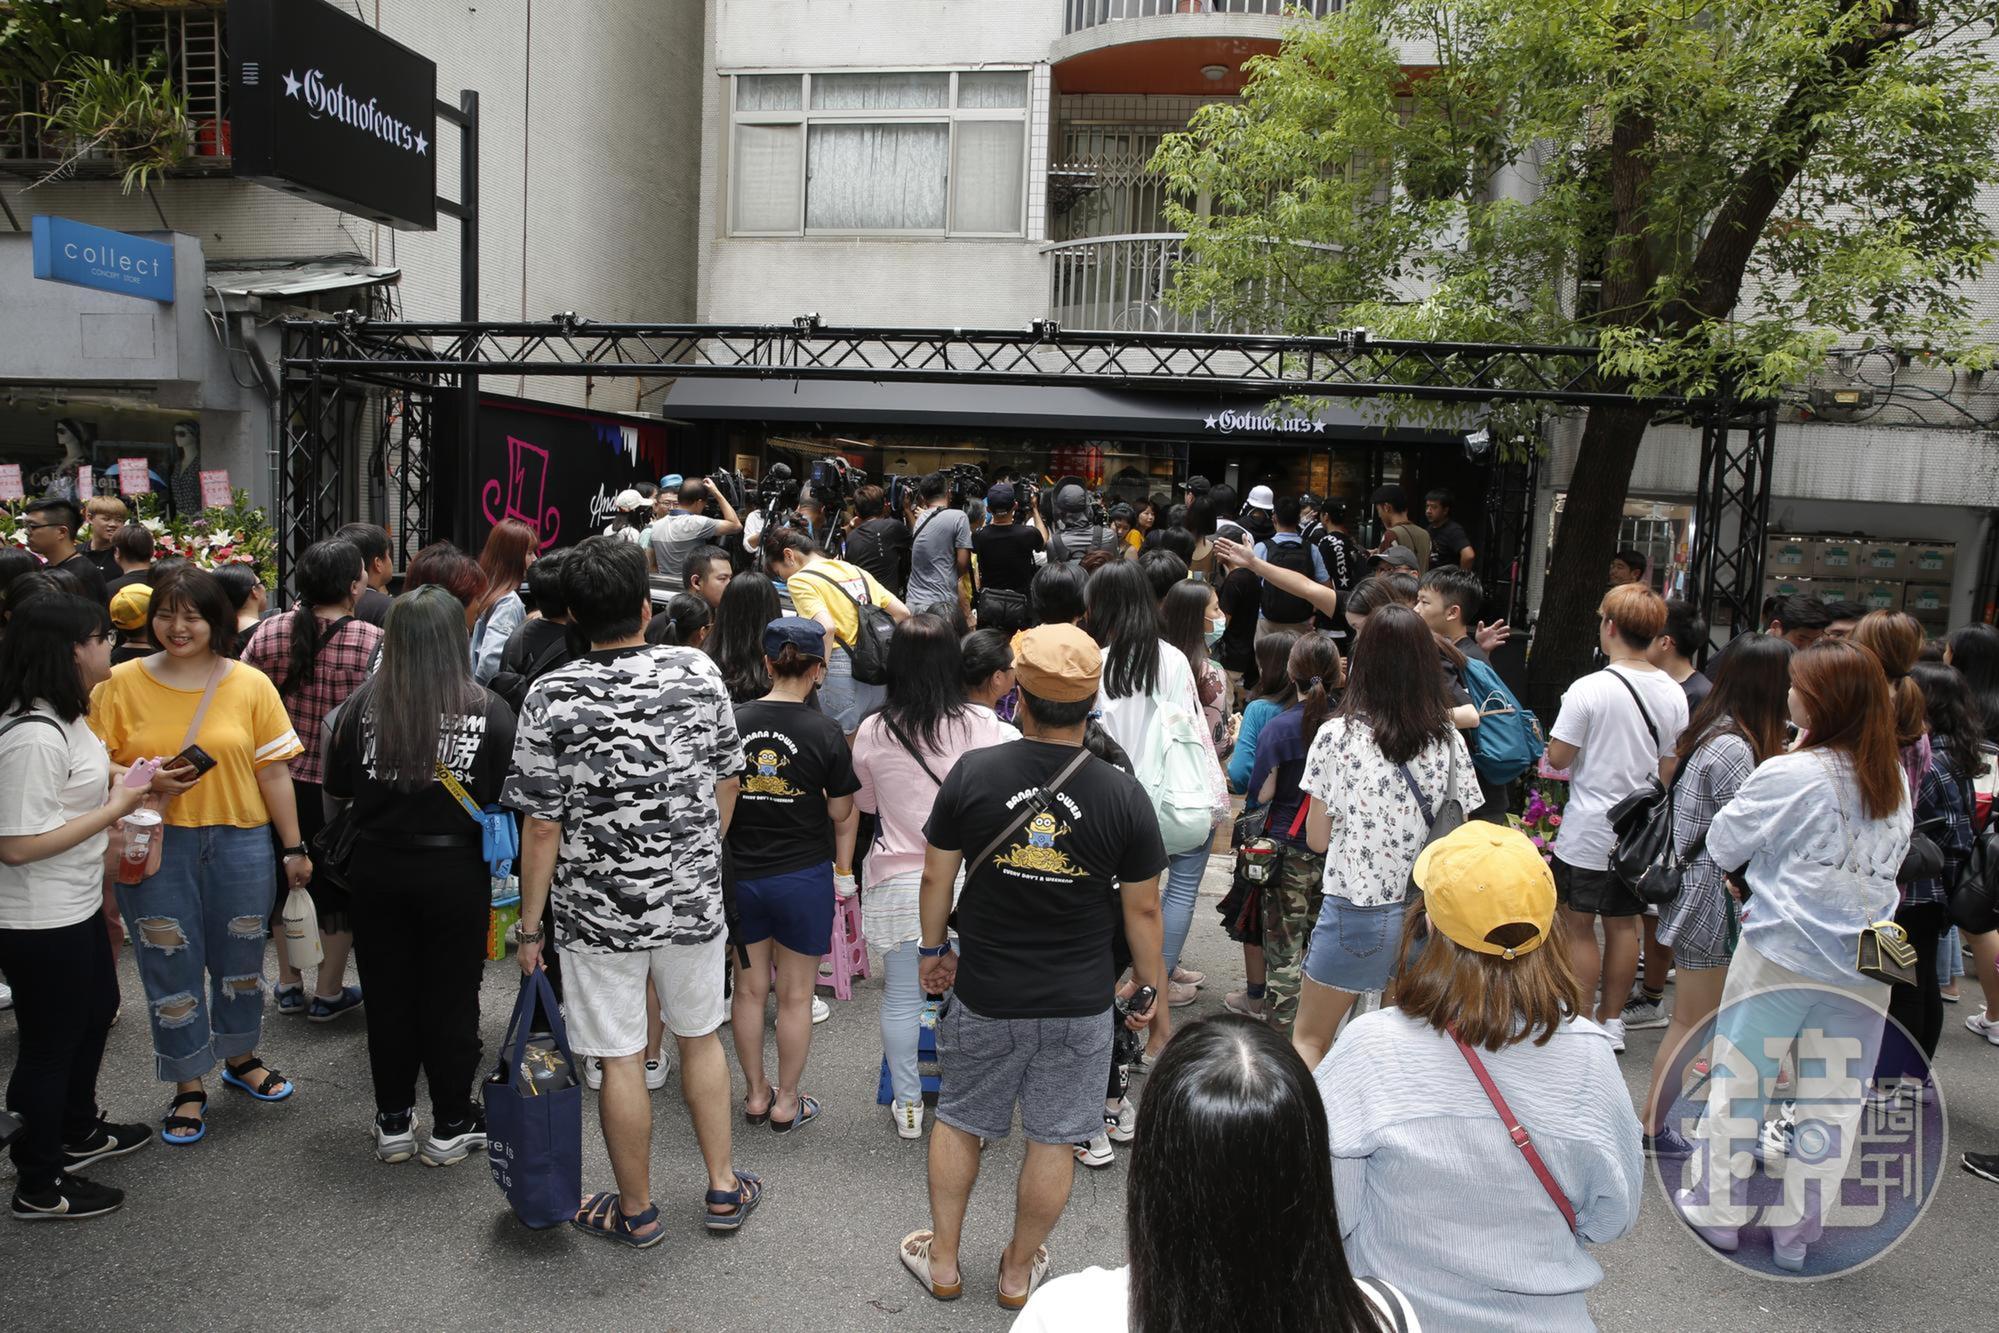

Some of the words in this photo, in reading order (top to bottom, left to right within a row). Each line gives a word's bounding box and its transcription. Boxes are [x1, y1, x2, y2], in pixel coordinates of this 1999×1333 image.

[64, 243, 159, 277] collect
[742, 731, 769, 749] ANANA
[772, 731, 798, 755] POWER
[1056, 792, 1082, 820] OWER
[1003, 868, 1021, 877] EVERY
